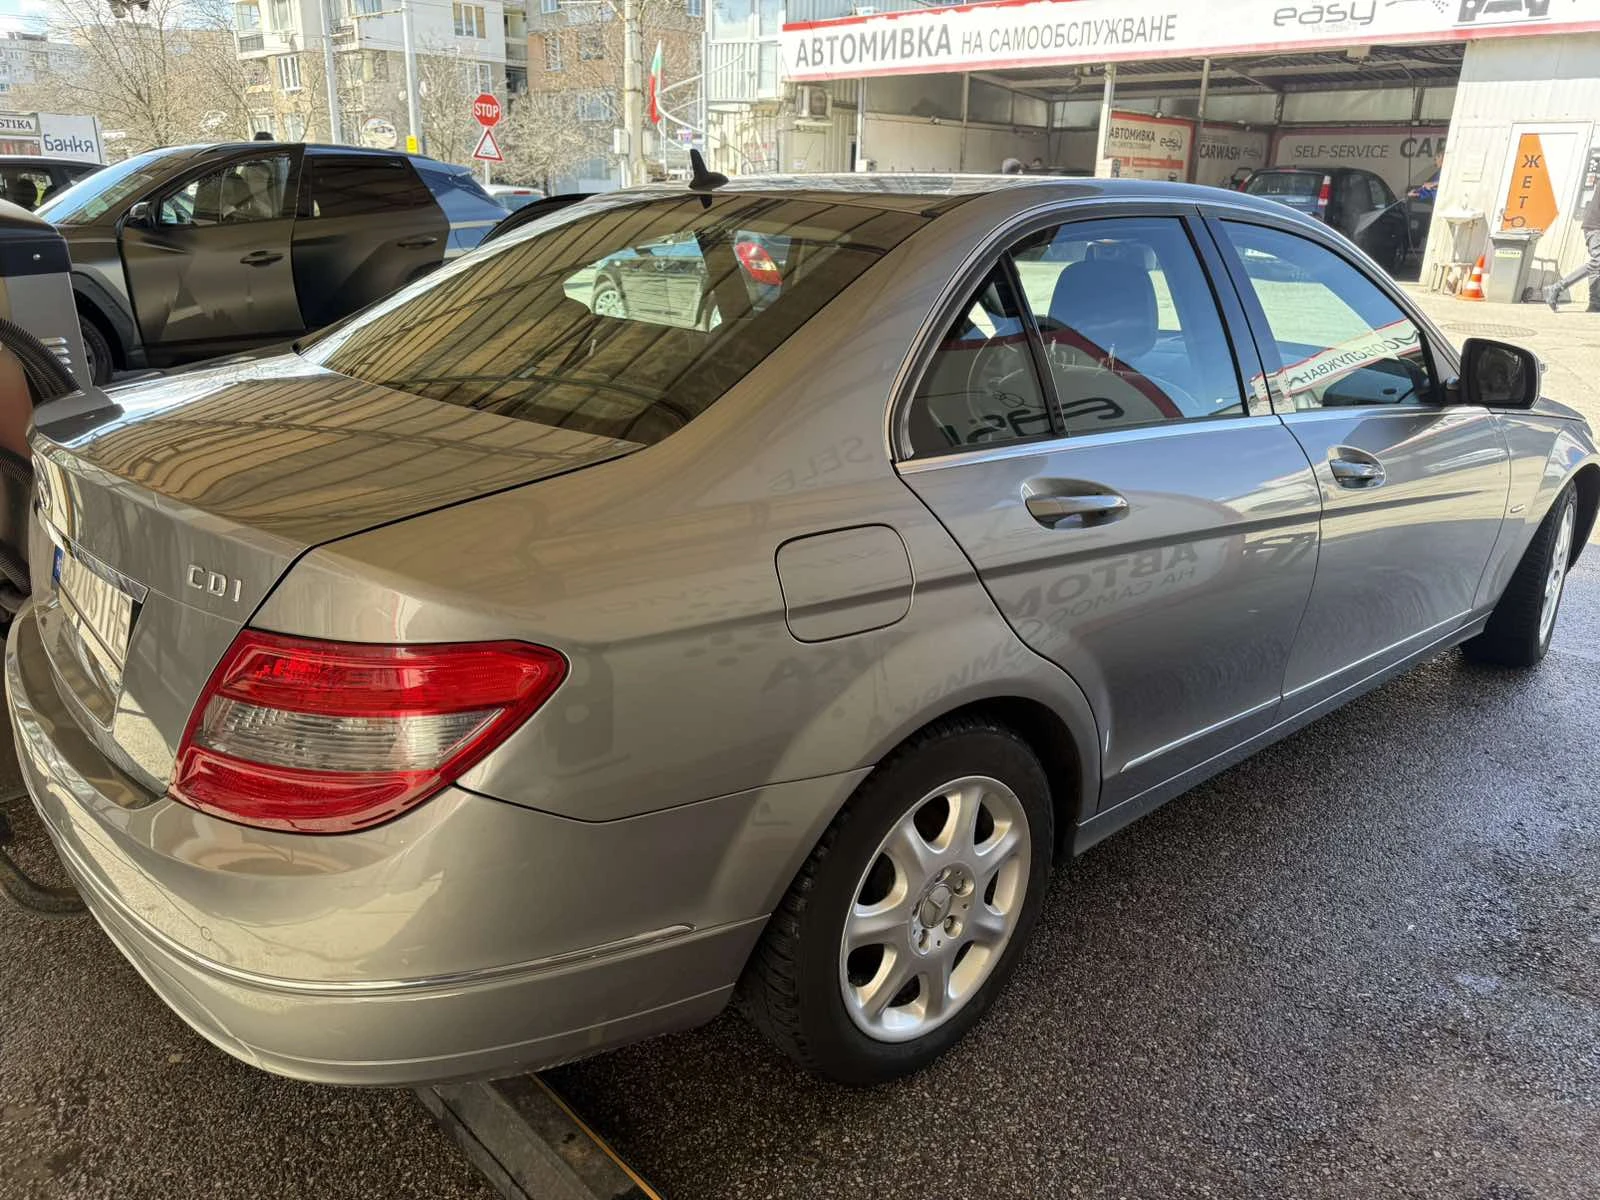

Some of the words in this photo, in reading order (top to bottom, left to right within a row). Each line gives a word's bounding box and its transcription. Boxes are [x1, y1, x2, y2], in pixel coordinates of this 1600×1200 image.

[1273, 0, 1376, 27] easy
[796, 23, 952, 68] АВТОМИВКА
[961, 29, 983, 55] НА
[989, 14, 1178, 53] САМООБСЛУЖВАНЕ
[475, 102, 499, 118] STOP
[43, 133, 95, 153] Банкя
[1109, 126, 1155, 143] АВТОМИВКА
[1200, 143, 1241, 161] CARWASH
[1294, 144, 1390, 159] SELF-SERVICE
[186, 564, 242, 602] CDI
